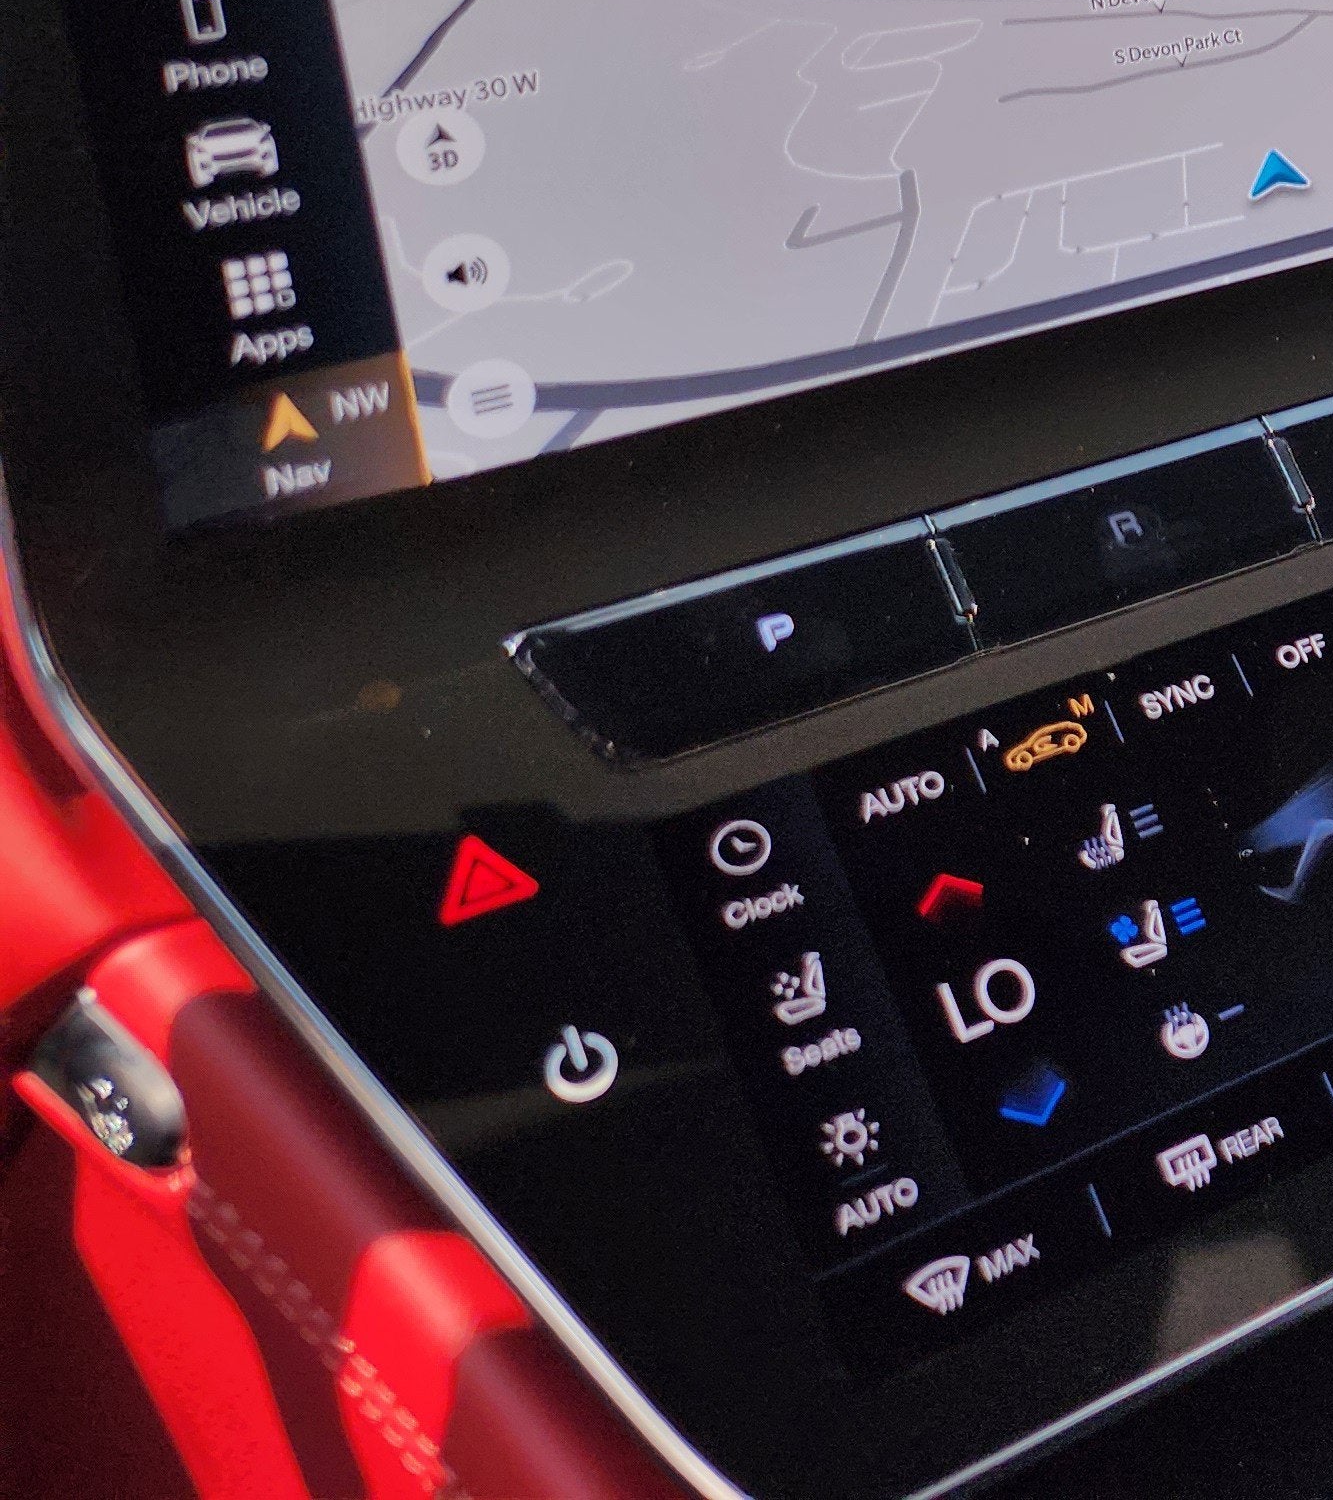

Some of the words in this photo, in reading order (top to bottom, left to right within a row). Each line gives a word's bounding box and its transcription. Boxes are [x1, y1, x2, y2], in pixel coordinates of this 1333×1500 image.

[1114, 49, 1127, 65] S
[1128, 40, 1181, 61] Devon
[1185, 33, 1222, 53] Park
[1223, 28, 1243, 45] Ct
[163, 56, 268, 94] Phone
[477, 77, 507, 101] 30
[513, 71, 538, 94] W
[429, 151, 458, 172] 3D
[183, 188, 300, 231] Vehicle
[230, 325, 314, 367] Apps
[330, 381, 389, 424] NW
[263, 459, 331, 498] Nav
[1109, 510, 1144, 546] R
[757, 613, 794, 653] P
[1277, 633, 1326, 670] OFF
[1068, 693, 1095, 719] M
[1140, 675, 1215, 720] SYNC
[861, 771, 945, 825] AUTO
[722, 883, 805, 930] Clock
[936, 957, 1037, 1045] LO
[781, 1027, 862, 1077] Seats
[1219, 1116, 1284, 1165] REAR
[835, 1177, 919, 1236] AUTO
[977, 1233, 1041, 1284] MAX
